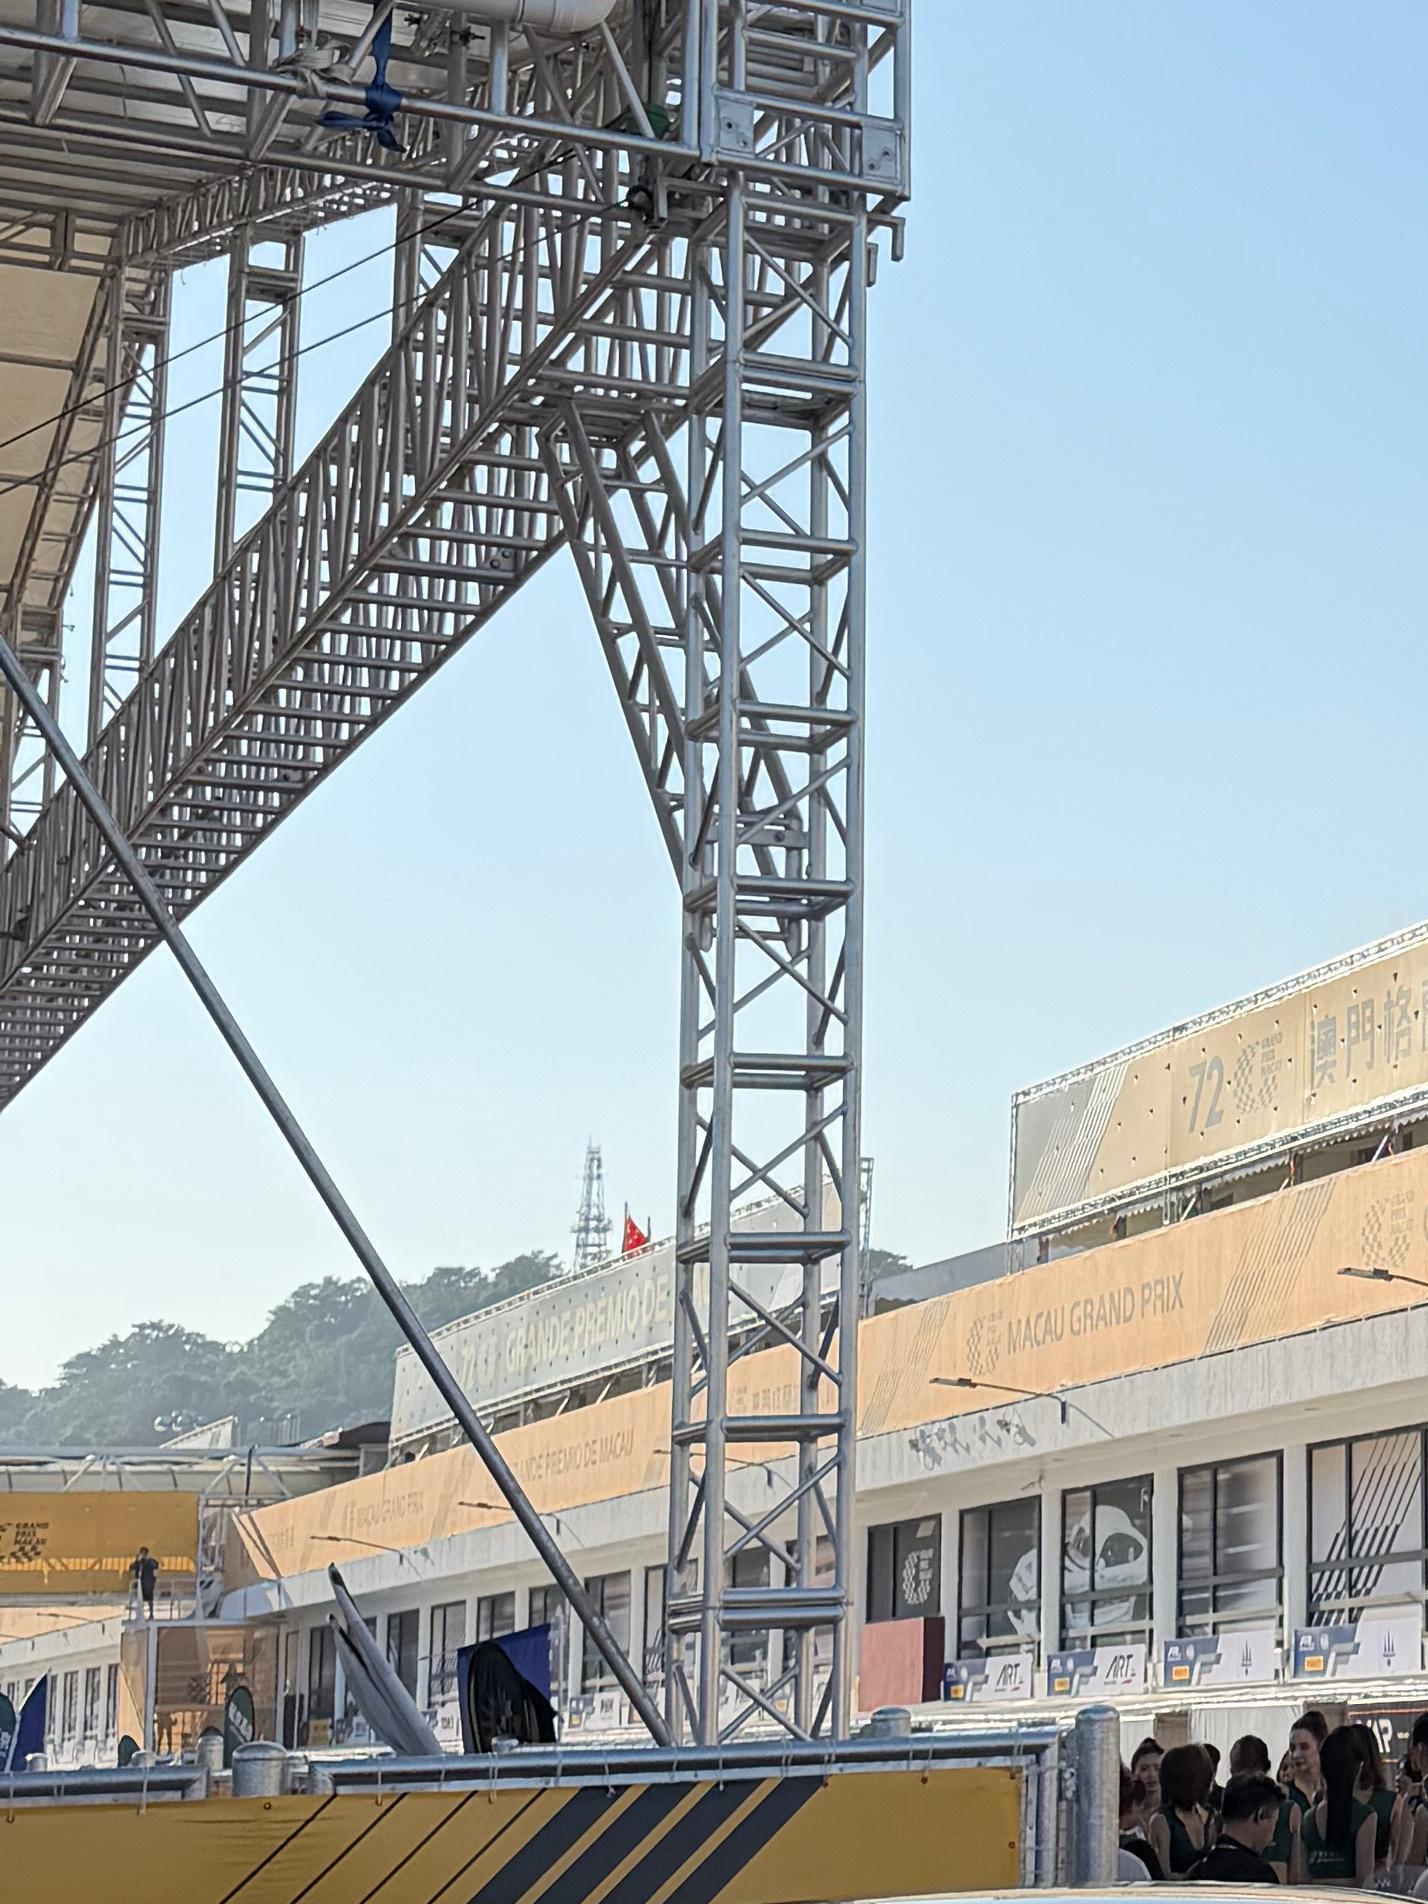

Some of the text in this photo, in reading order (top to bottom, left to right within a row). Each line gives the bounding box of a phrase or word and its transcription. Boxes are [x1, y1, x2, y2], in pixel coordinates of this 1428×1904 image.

[1187, 1056, 1225, 1134] 72
[505, 1311, 571, 1371] GRANDE
[1006, 1272, 1185, 1353] MACAU GRAND PRIX
